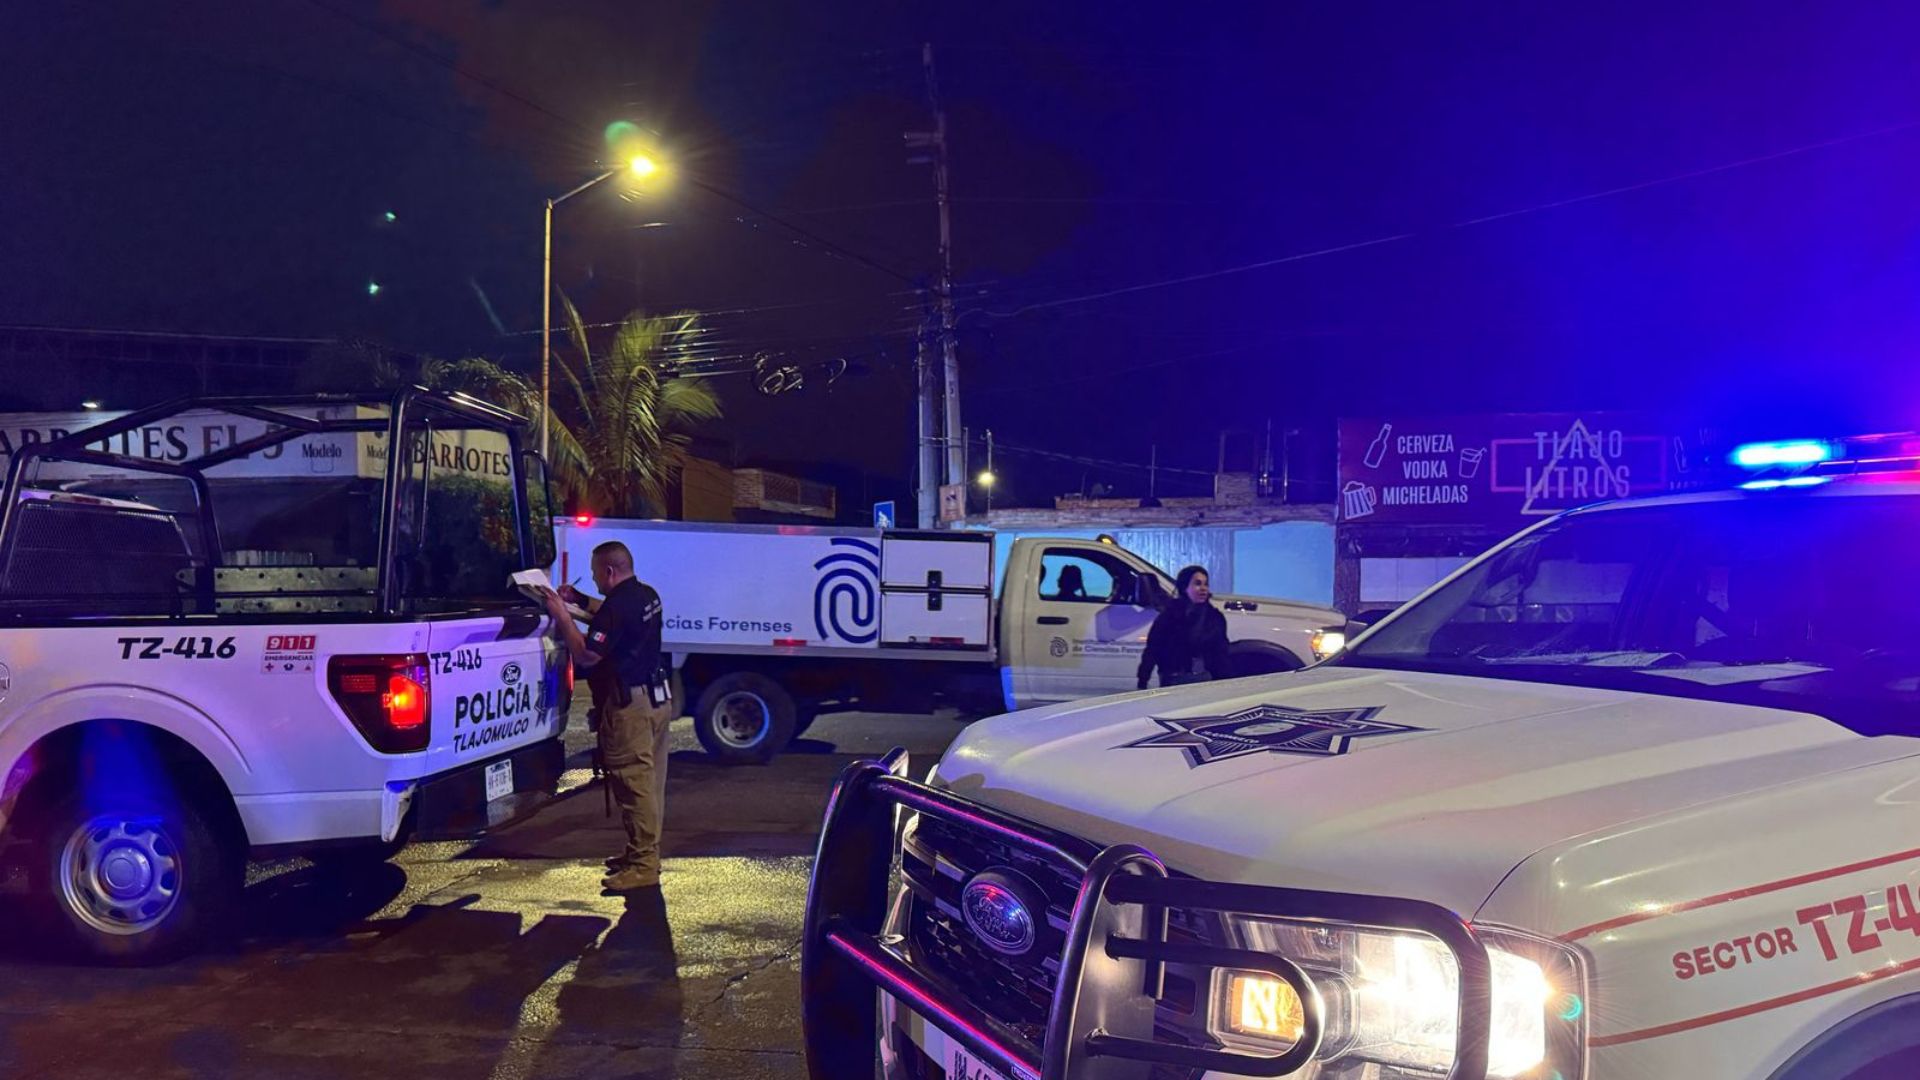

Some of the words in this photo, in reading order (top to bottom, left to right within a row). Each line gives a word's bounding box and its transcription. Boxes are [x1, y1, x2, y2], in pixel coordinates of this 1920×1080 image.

[302, 443, 342, 459] Modelo
[1397, 435, 1455, 454] CERVEZA
[1403, 460, 1448, 479] VODKA
[1525, 465, 1630, 499] LITROS
[1383, 485, 1469, 505] MICHELADAS
[661, 615, 703, 630] cias
[708, 616, 793, 633] Forenses
[117, 636, 236, 660] TZ-416
[268, 636, 313, 649] 911
[430, 648, 482, 675] TZ-416
[455, 682, 531, 728] POLICÍA
[453, 717, 529, 754] TLAJOMULCO
[1672, 927, 1798, 980] SECTOR
[1796, 883, 1920, 962] TZ-4
